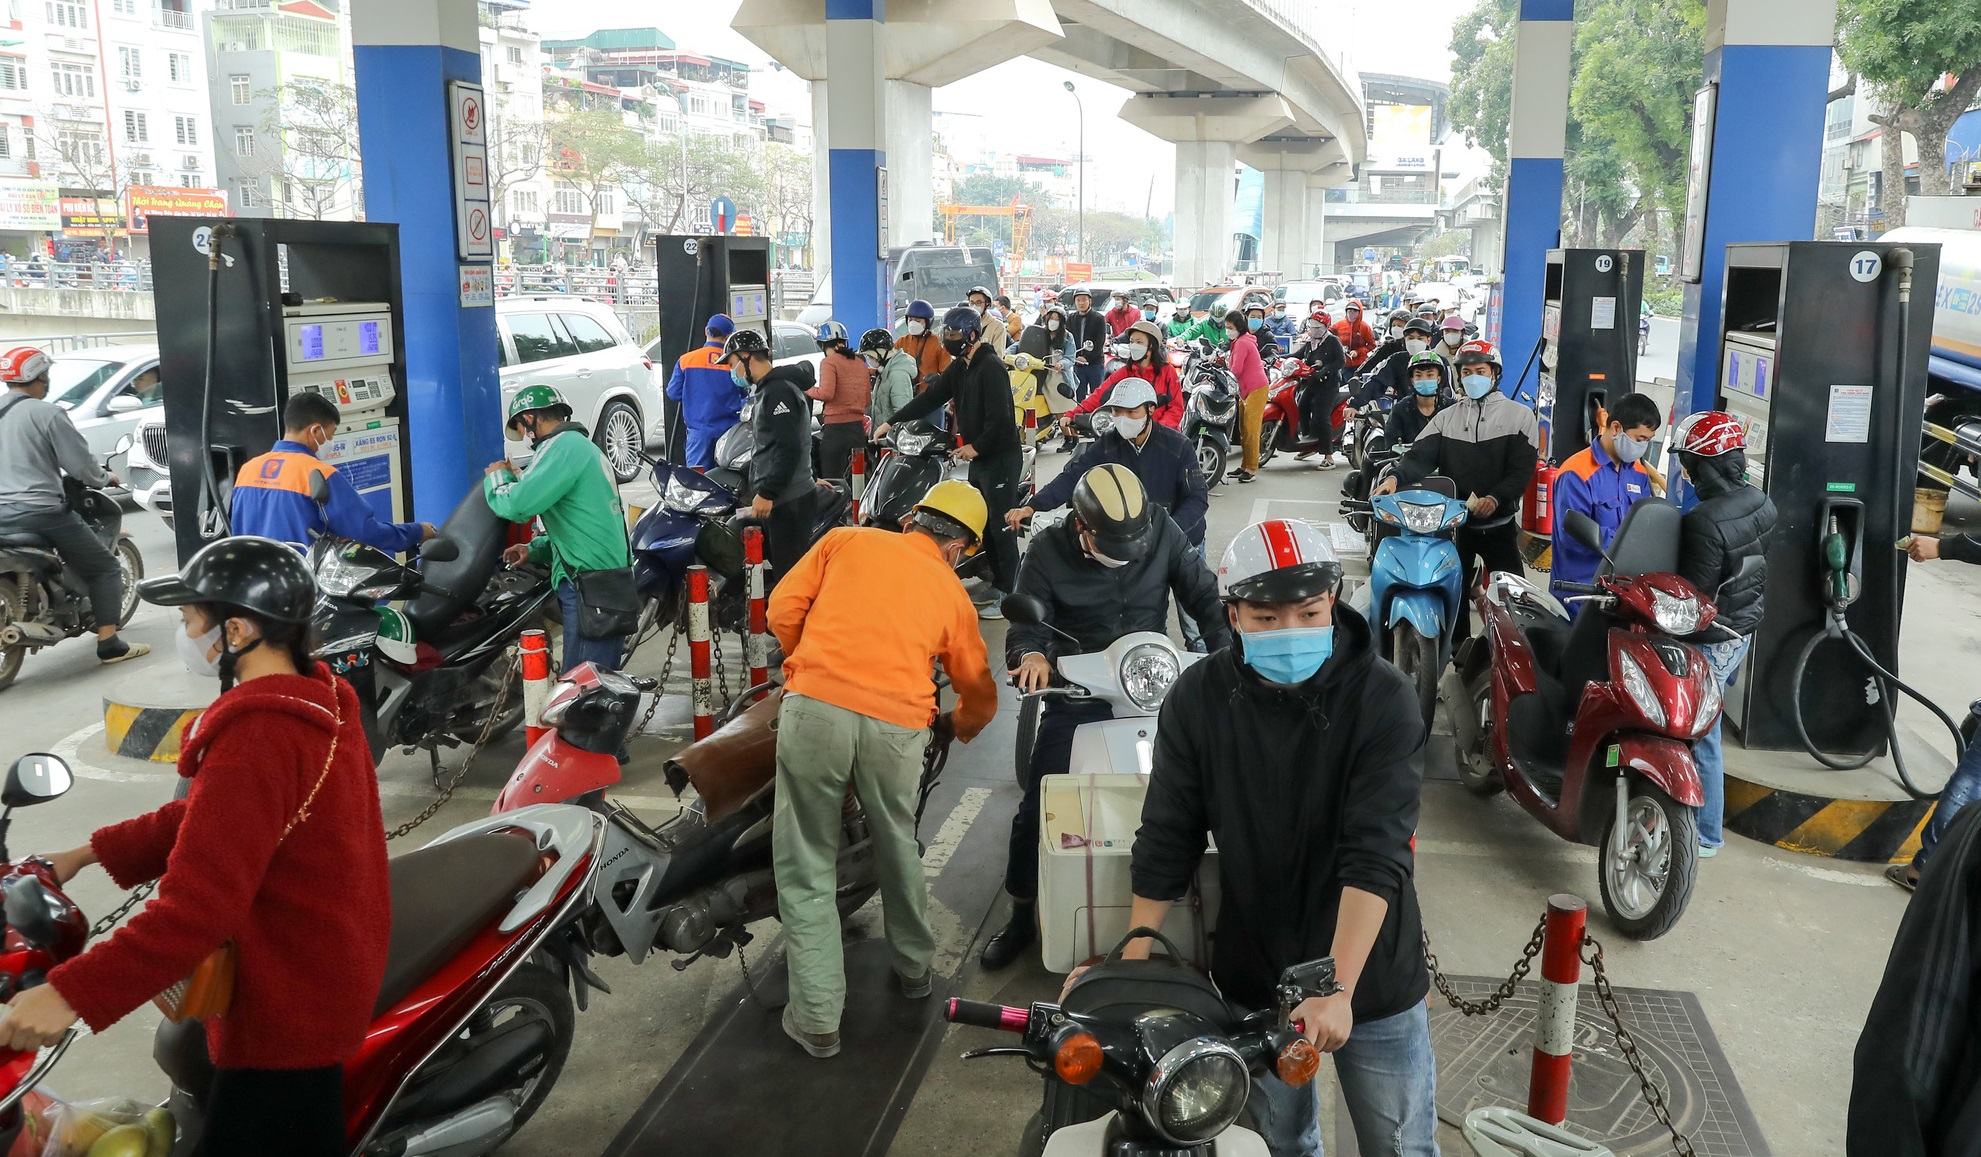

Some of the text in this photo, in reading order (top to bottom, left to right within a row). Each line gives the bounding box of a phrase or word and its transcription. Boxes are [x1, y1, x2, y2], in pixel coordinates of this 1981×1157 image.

[151, 197, 173, 209] Trang
[686, 243, 697, 251] 22
[1599, 260, 1610, 268] 19
[1855, 259, 1877, 275] 17
[513, 391, 535, 410] Grab
[600, 847, 629, 871] HONDA
